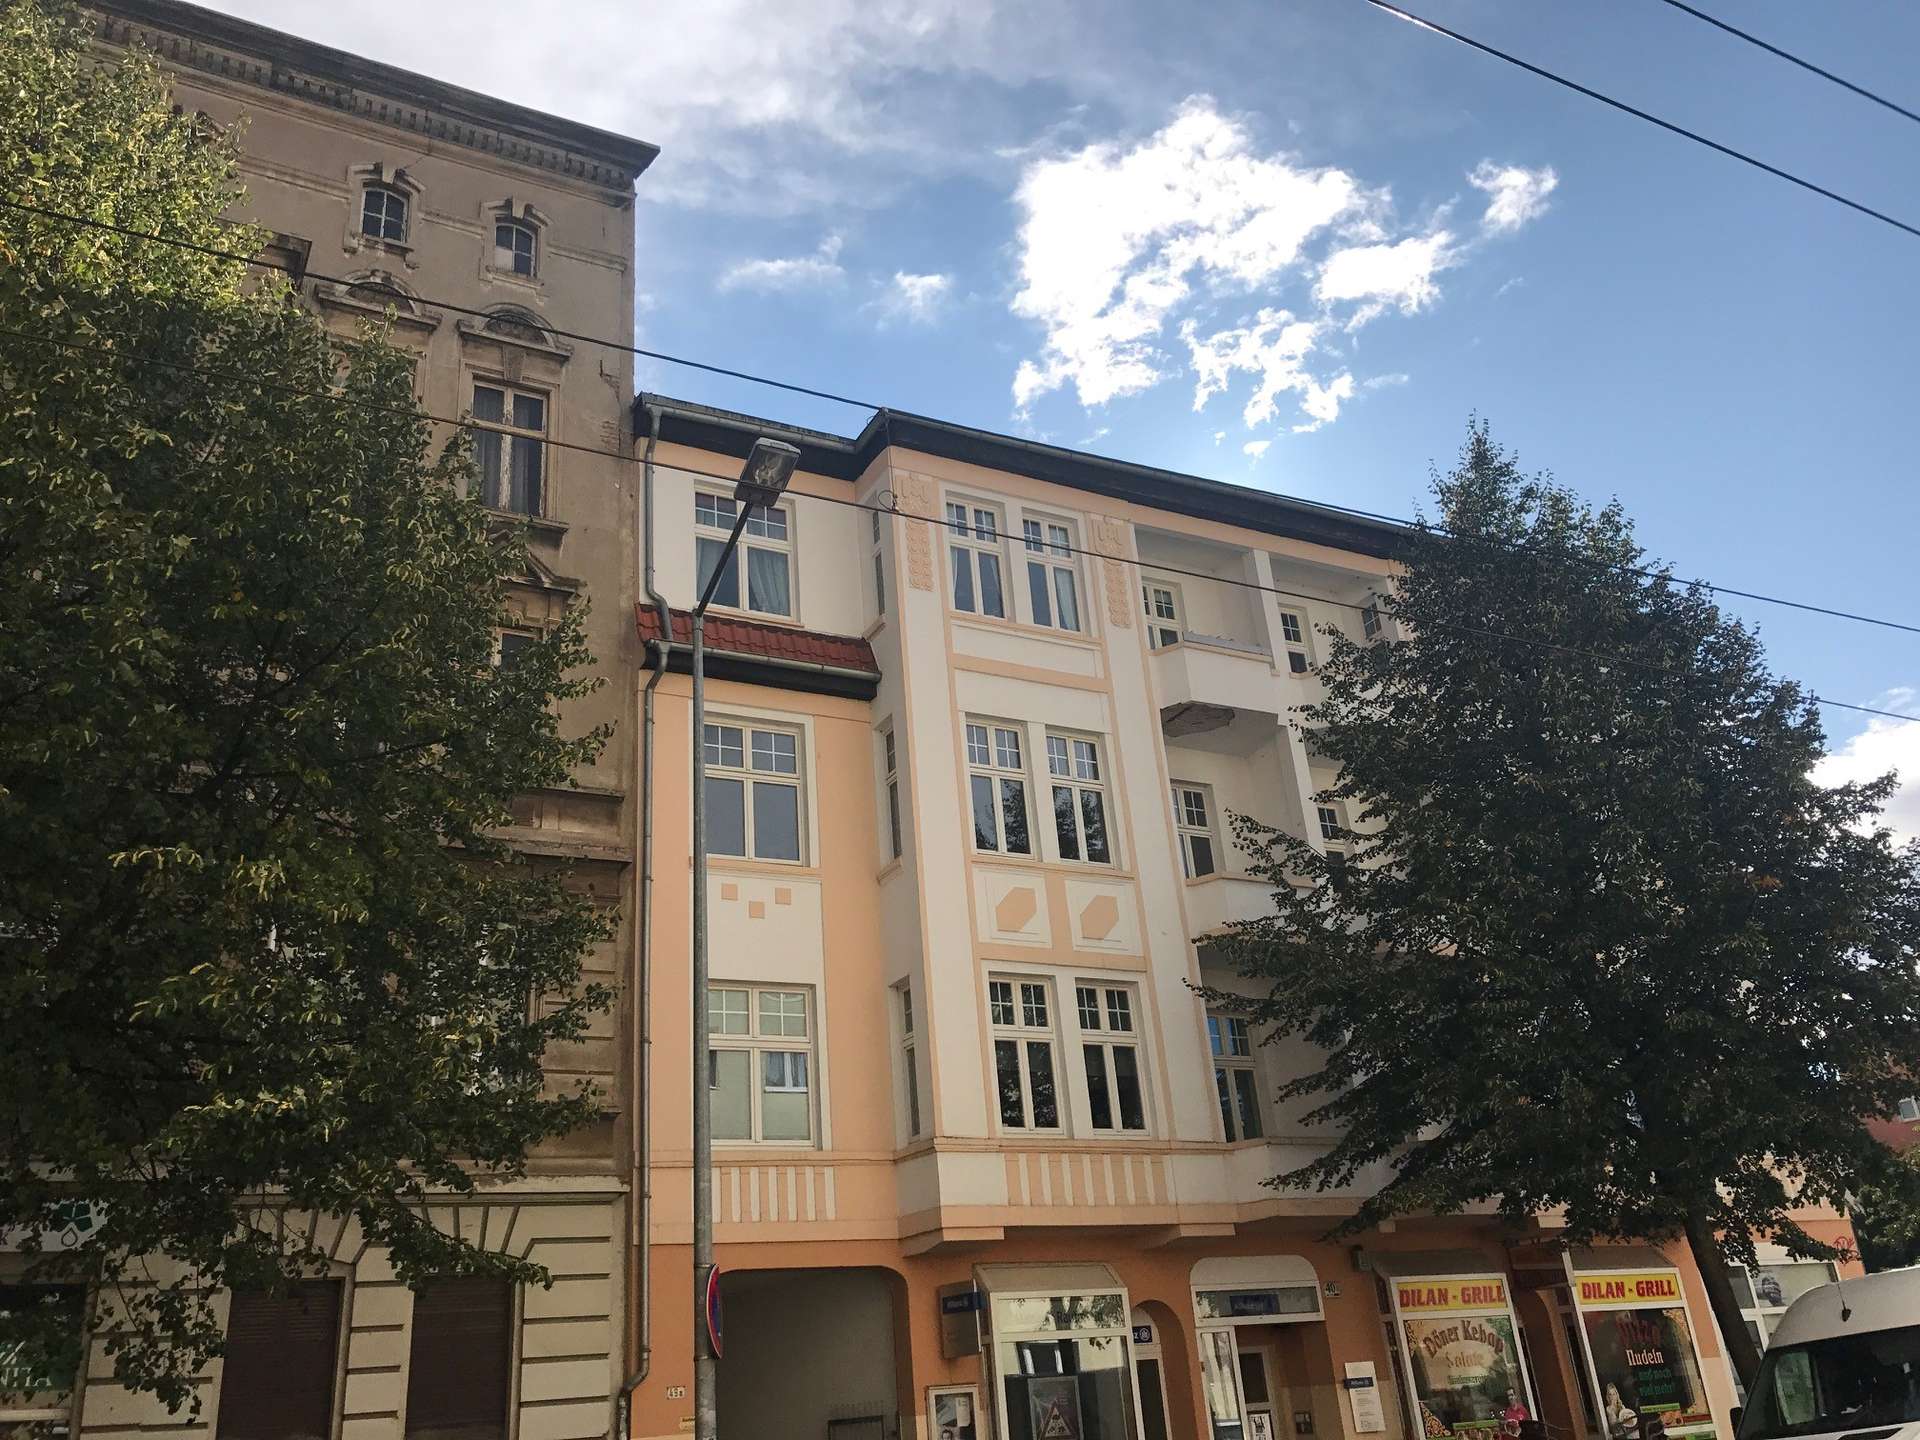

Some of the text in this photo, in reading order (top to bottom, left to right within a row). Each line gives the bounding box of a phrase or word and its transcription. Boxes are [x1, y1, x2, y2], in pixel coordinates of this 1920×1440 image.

[1398, 1288, 1449, 1308] DILAN
[1460, 1285, 1506, 1305] GRILL
[1581, 1281, 1625, 1300] DILAN
[1635, 1279, 1676, 1297] GRILL
[1625, 1348, 1665, 1367] Nudeln
